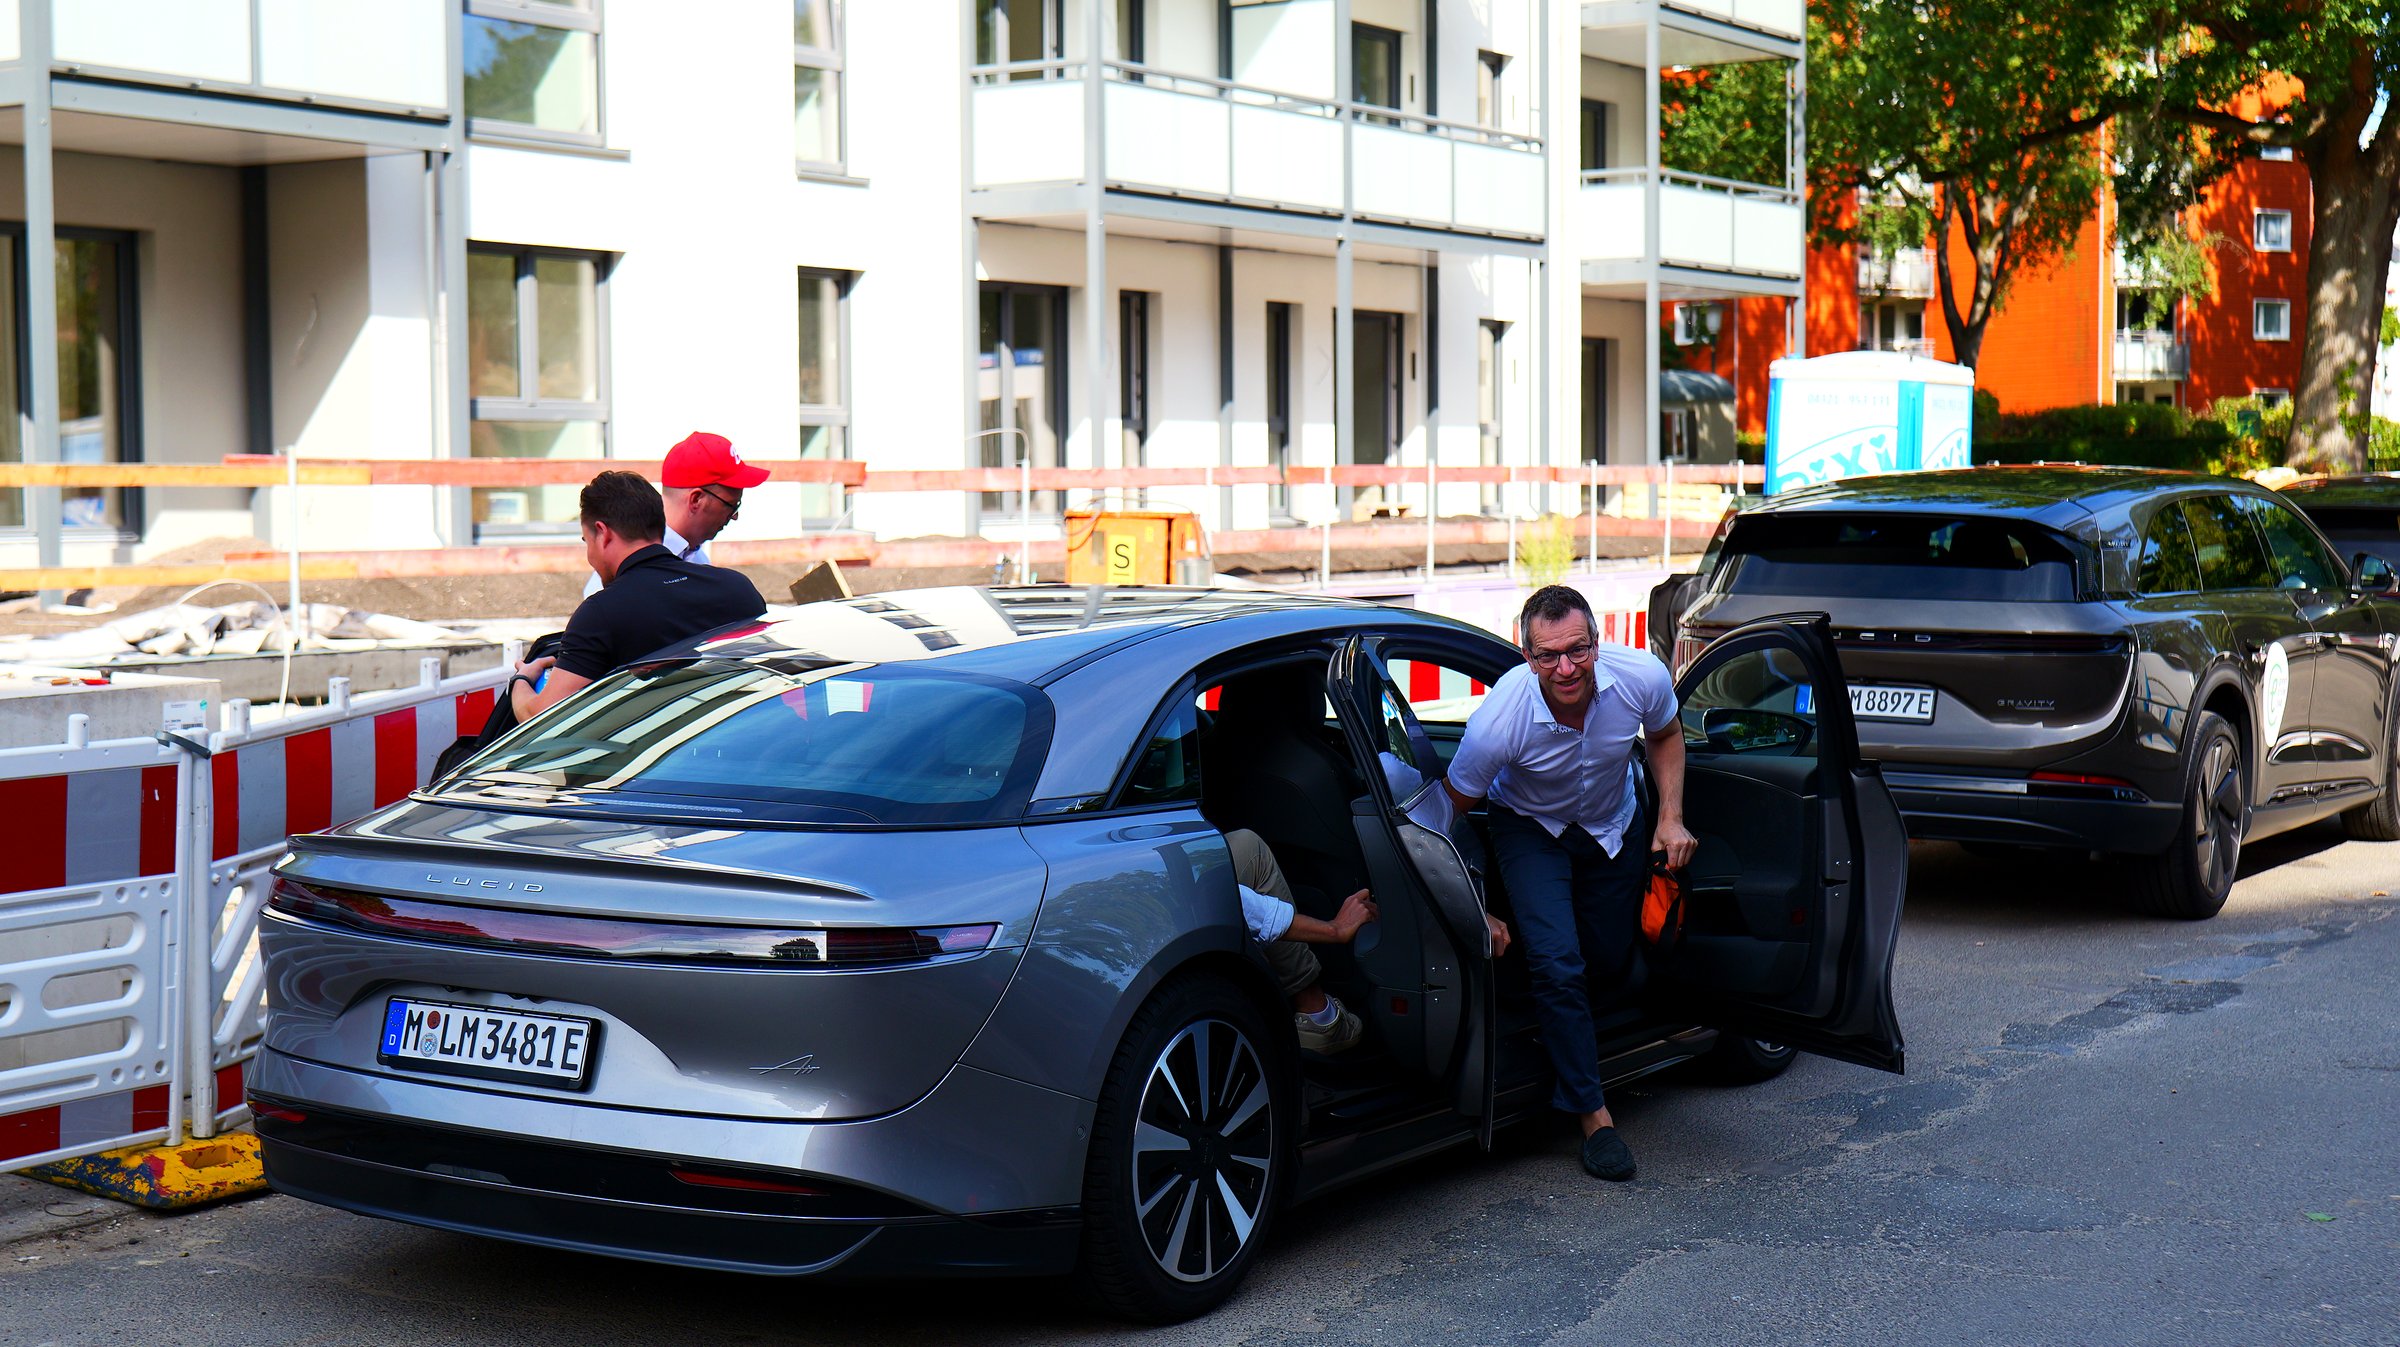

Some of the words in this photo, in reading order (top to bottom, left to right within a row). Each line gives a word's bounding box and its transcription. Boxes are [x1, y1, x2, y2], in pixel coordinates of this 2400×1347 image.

[1114, 543, 1130, 569] S
[1997, 699, 2055, 708] GRAVITY
[426, 874, 544, 893] LUCID
[388, 1034, 396, 1046] D
[402, 1009, 424, 1051] M
